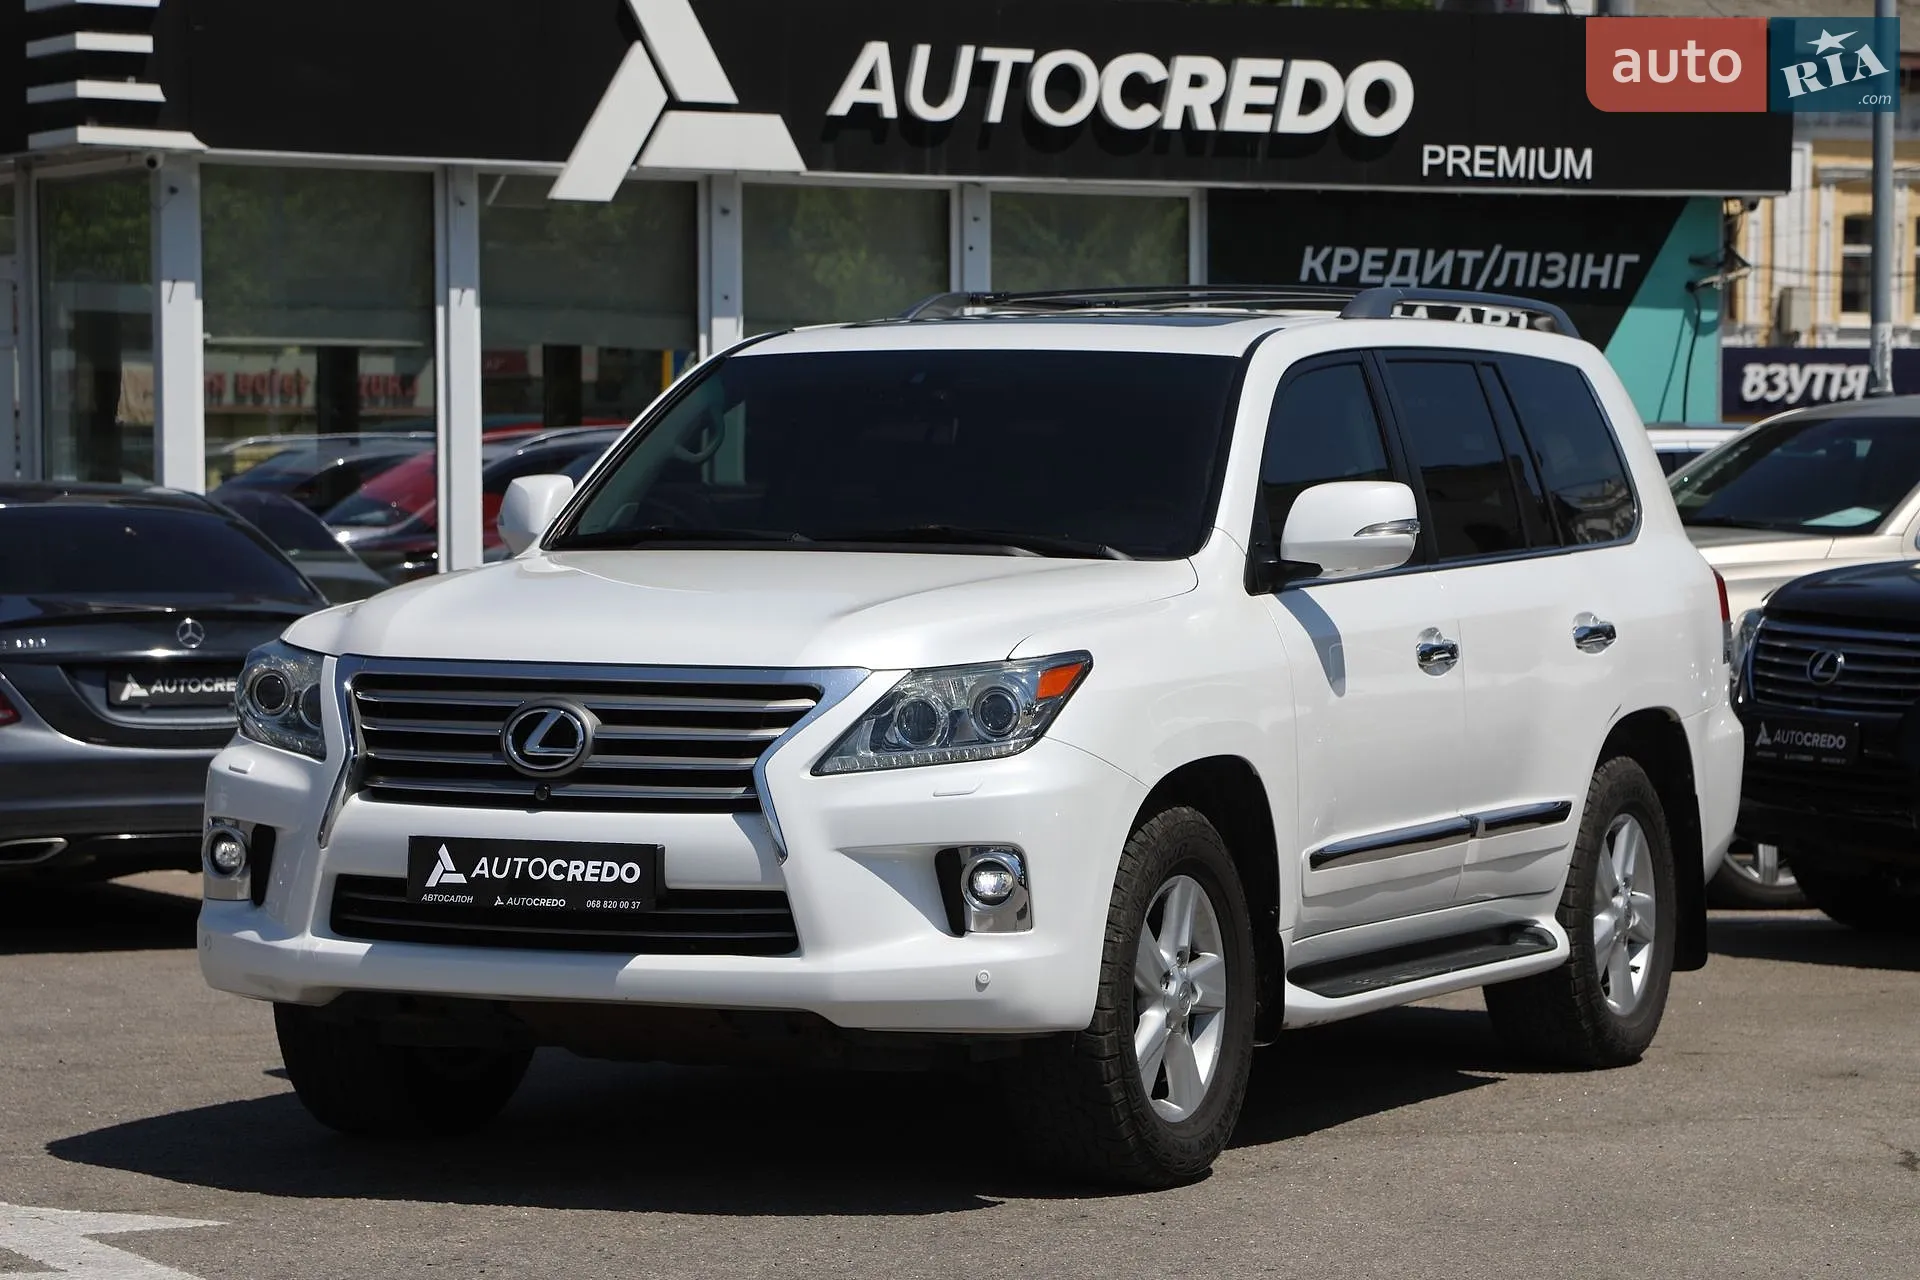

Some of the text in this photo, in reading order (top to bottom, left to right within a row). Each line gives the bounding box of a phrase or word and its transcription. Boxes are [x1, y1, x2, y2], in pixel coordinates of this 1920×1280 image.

[827, 40, 1415, 138] AUTOCREDO
[1421, 143, 1594, 181] PREMIUM
[1299, 244, 1641, 291] КРЕДИТ/ЛІЗІНГ
[1773, 728, 1846, 749] AUTOCREDO
[470, 856, 641, 883] AUTOCREDO
[421, 893, 473, 904] АВТОСАЛОН
[506, 896, 566, 907] AUTOCREDO
[586, 899, 641, 909] 068 820 00 37
